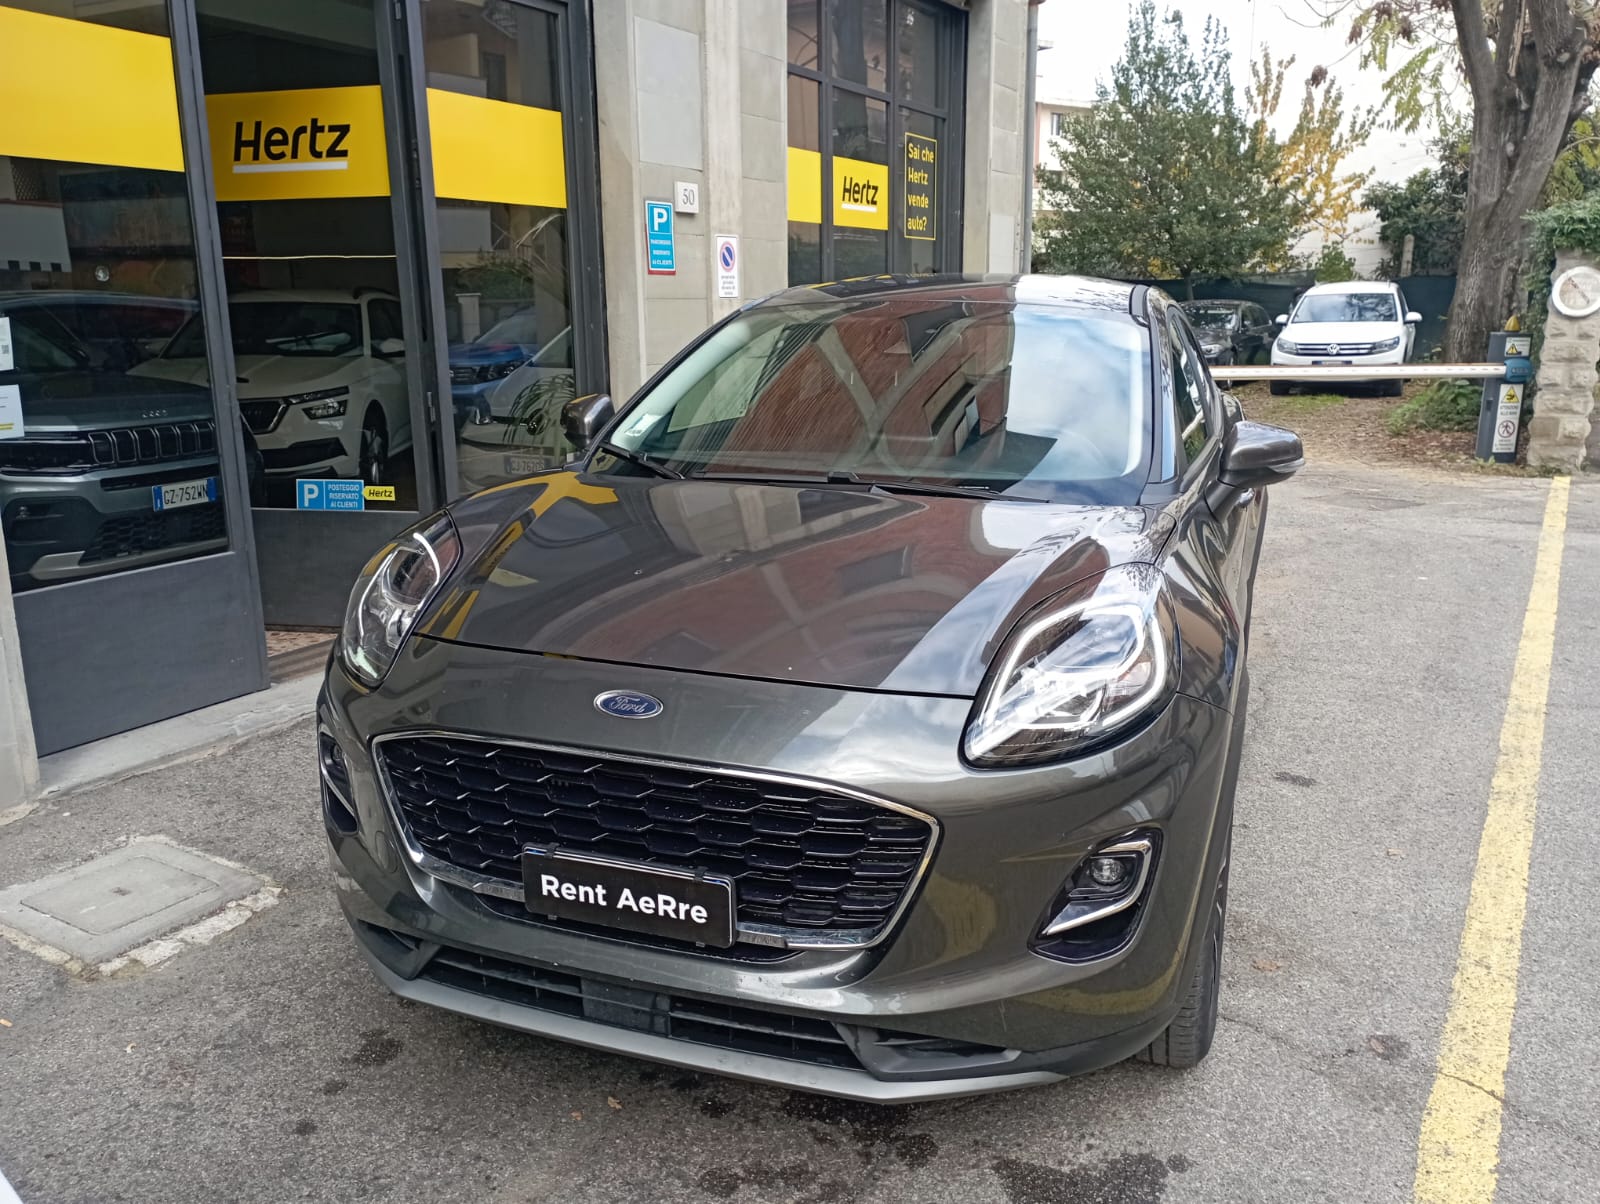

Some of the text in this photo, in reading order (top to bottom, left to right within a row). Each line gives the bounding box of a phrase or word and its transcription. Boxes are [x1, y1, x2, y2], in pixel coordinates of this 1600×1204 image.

[233, 117, 351, 162] Hertz
[908, 143, 935, 163] Sai che
[907, 167, 929, 185] Hertz
[682, 188, 695, 206] 50
[842, 175, 879, 206] Hertz
[907, 193, 929, 209] vende
[653, 207, 669, 232] P
[907, 216, 928, 232] auto?
[303, 484, 319, 508] P
[329, 492, 359, 500] RISERVATO
[368, 489, 393, 498] Hertz
[609, 695, 646, 714] Ford
[540, 874, 709, 924] Rent AeRre
